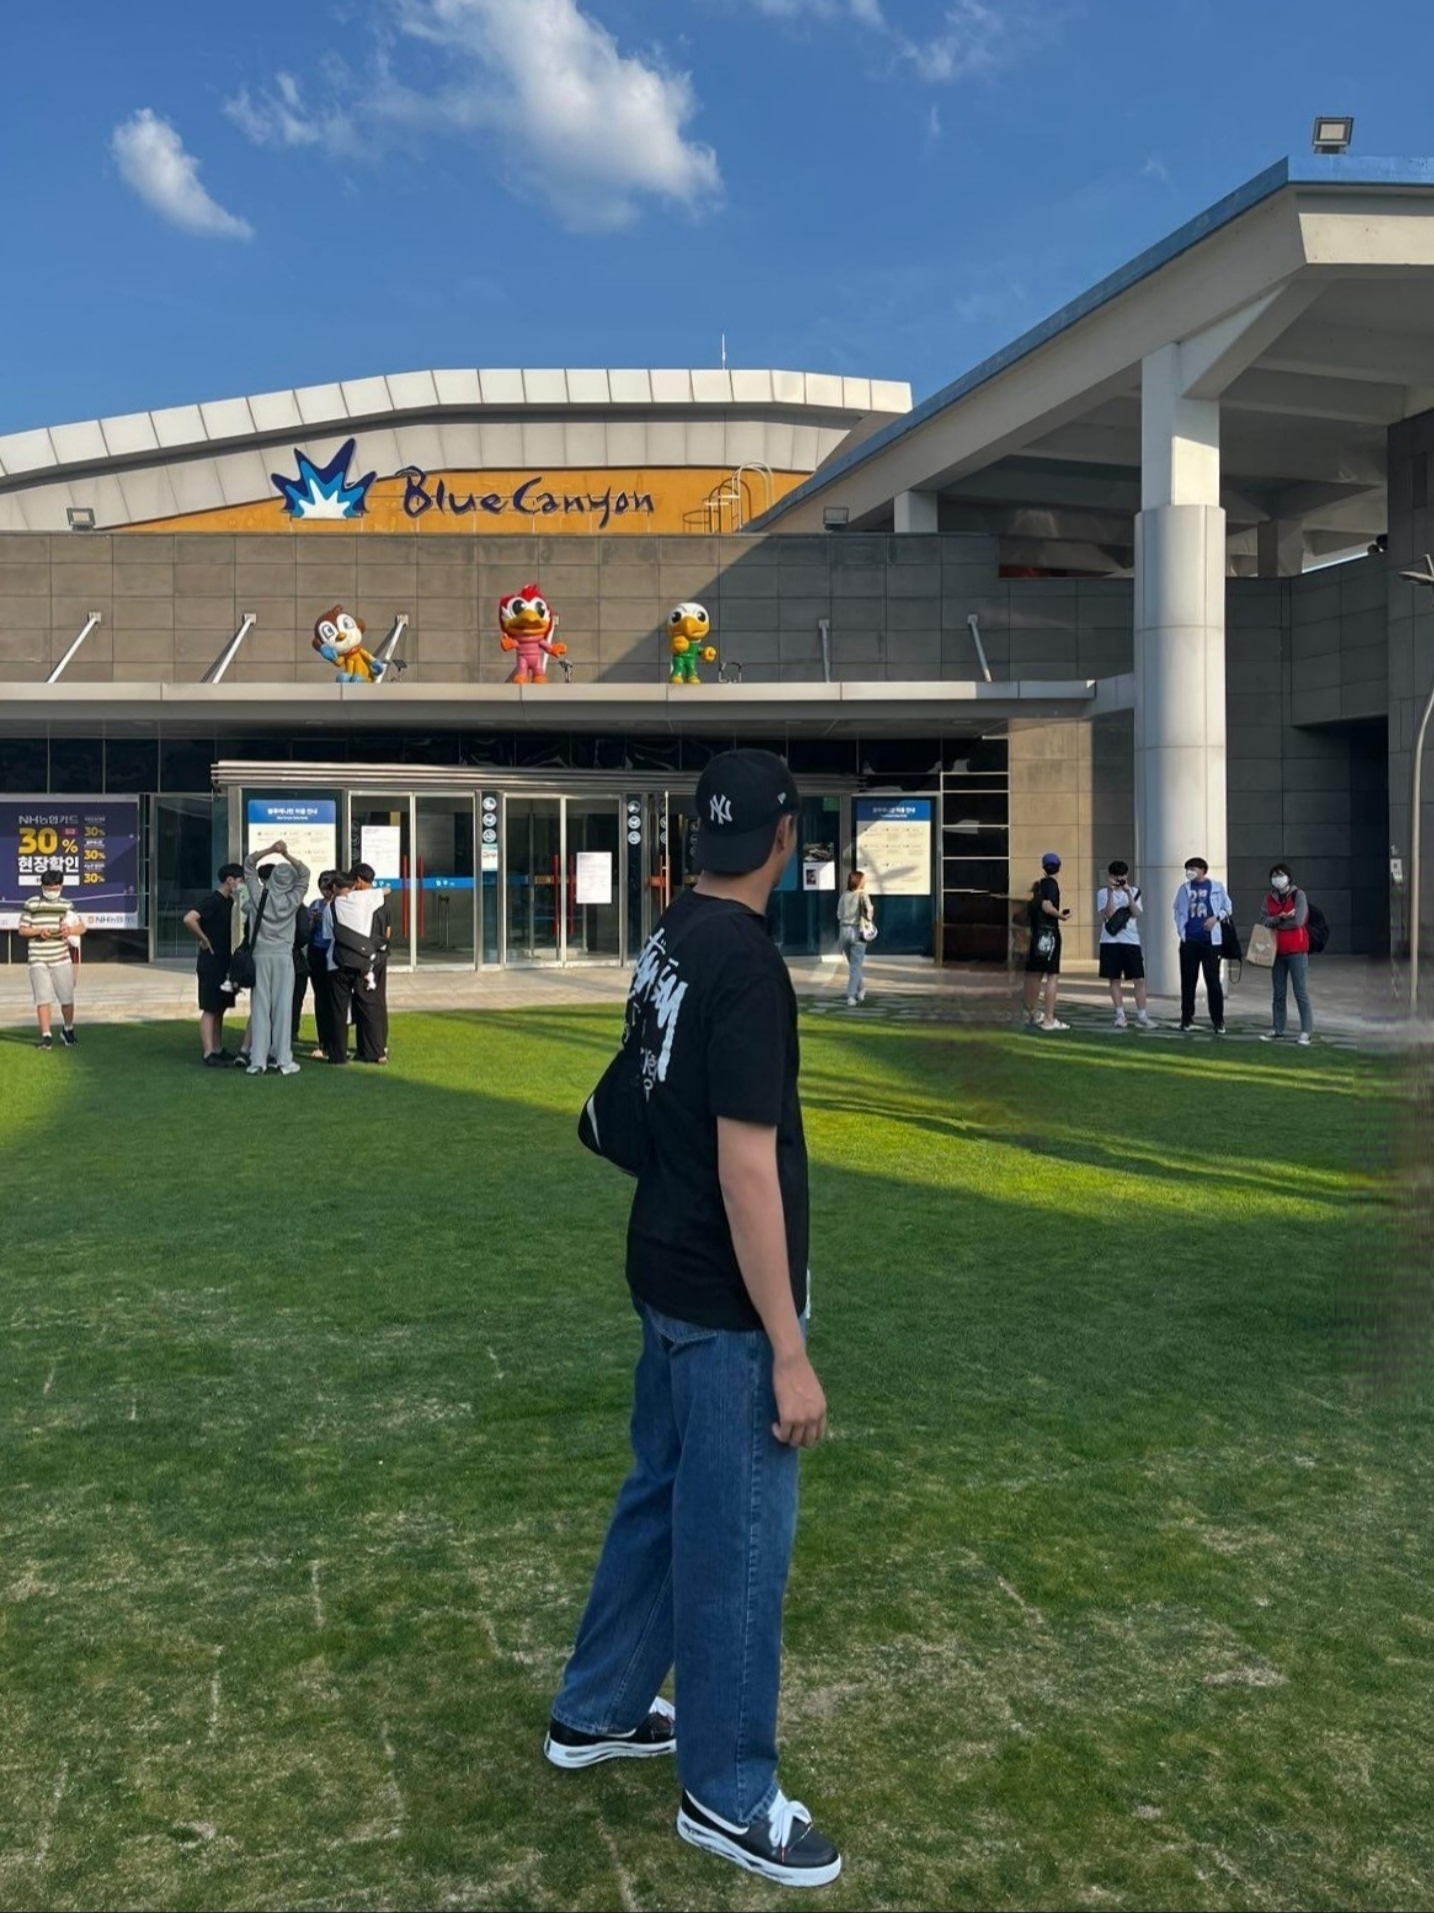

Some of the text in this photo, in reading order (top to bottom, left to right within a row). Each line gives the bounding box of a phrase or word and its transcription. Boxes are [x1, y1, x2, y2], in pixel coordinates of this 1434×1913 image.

[395, 466, 654, 529] Blue Canyon
[709, 794, 733, 824] NY
